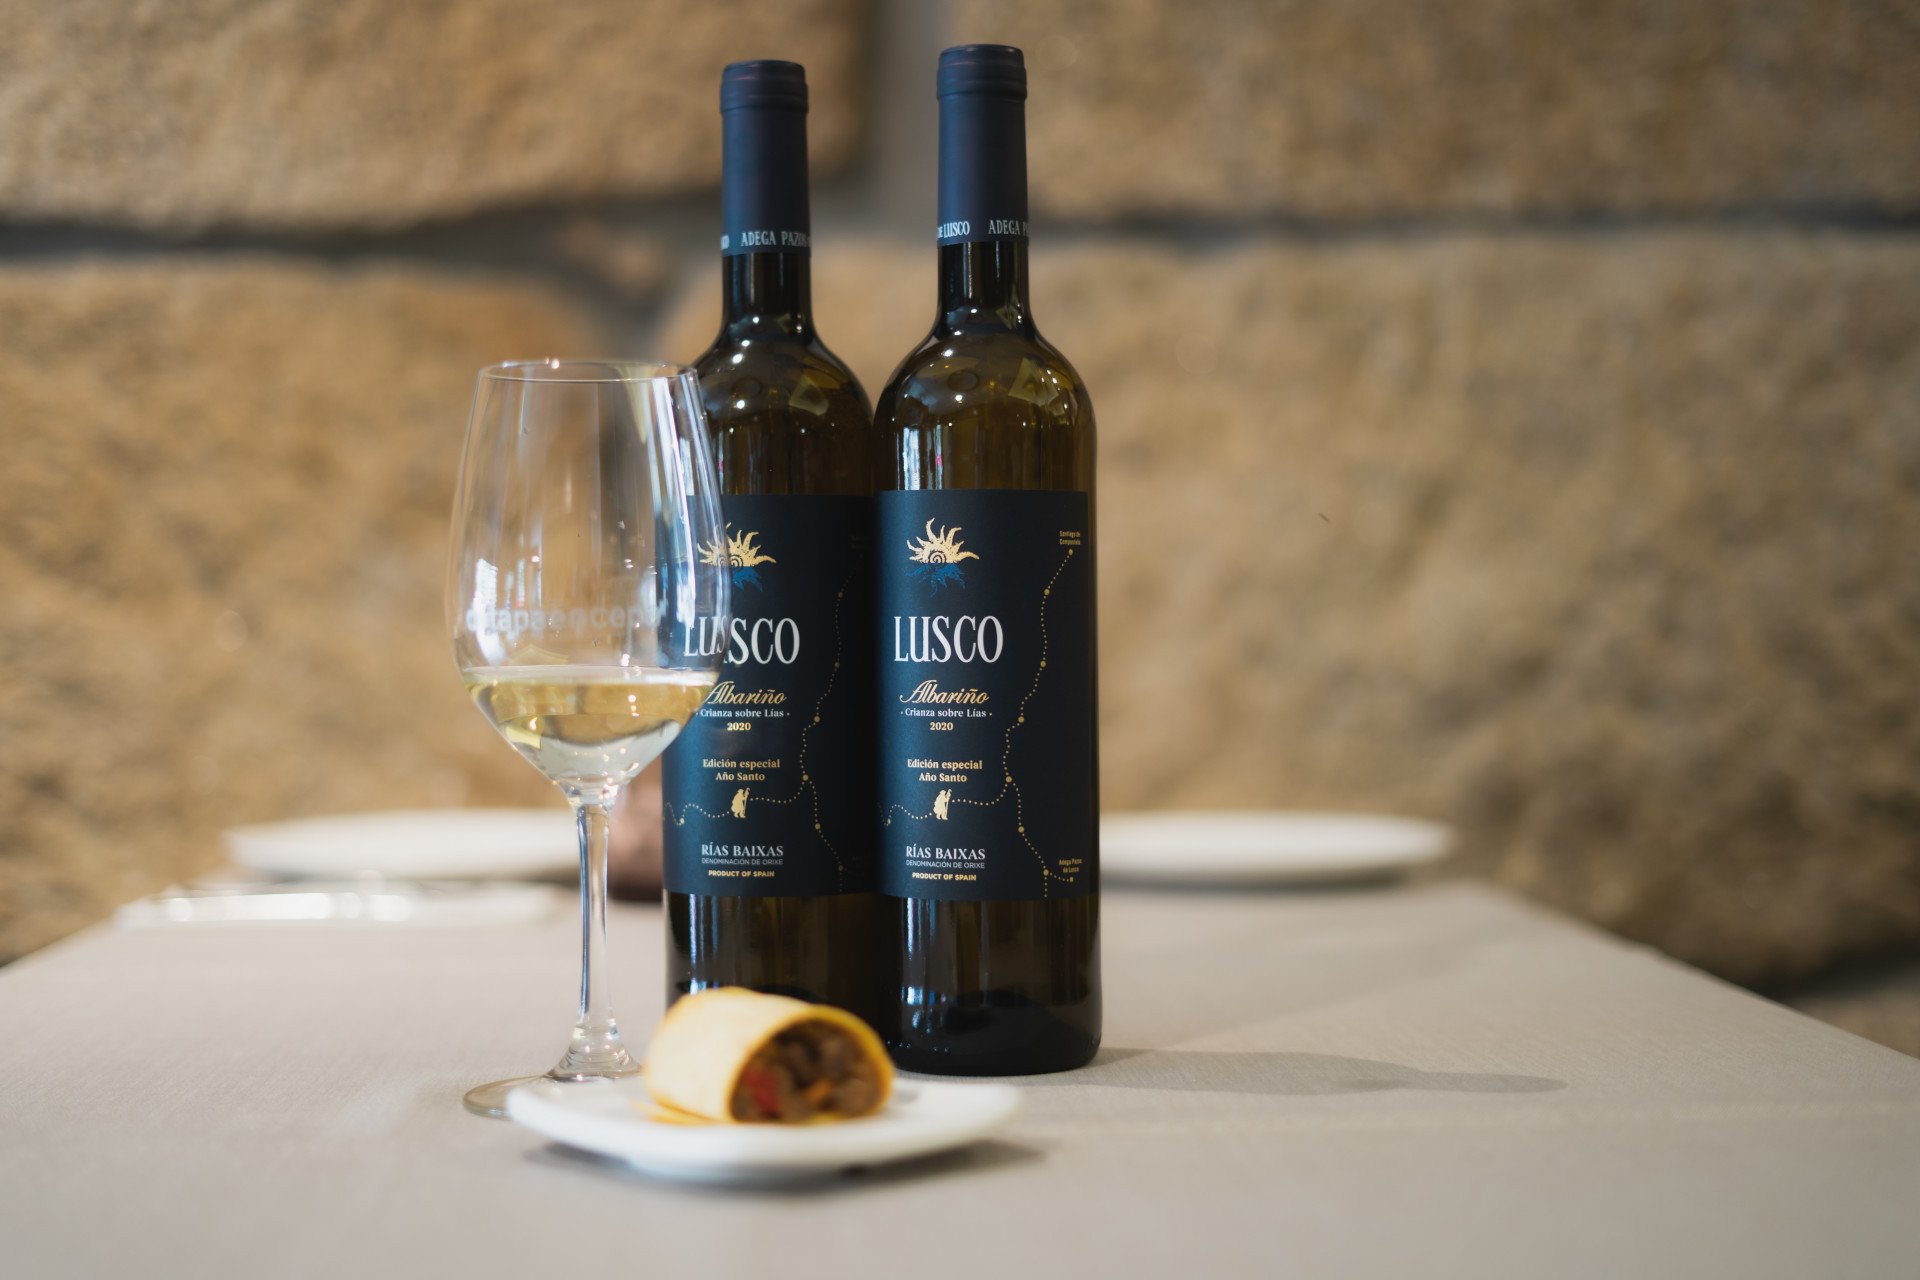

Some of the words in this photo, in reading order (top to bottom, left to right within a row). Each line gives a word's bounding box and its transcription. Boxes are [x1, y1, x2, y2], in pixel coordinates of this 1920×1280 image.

[944, 220, 970, 239] LUSCO
[988, 219, 1021, 236] ADEGA
[741, 231, 777, 247] ADEGA
[894, 615, 1004, 663] LUSCO
[704, 681, 787, 705] Albariño
[899, 679, 990, 704] Albariño
[700, 708, 733, 718] Crianza
[735, 708, 762, 718] sobre
[764, 708, 785, 718] Lías
[905, 707, 935, 717] Crianza
[937, 708, 964, 718] sobre
[966, 708, 987, 718] Lías
[727, 721, 752, 731] 2020
[929, 721, 954, 731] 2020
[702, 758, 737, 769] Edición
[739, 759, 781, 771] especial
[907, 758, 939, 769] Edición
[941, 760, 983, 772] especial
[715, 771, 735, 781] Año
[737, 771, 766, 781] Santo
[918, 772, 937, 782] Año
[939, 773, 967, 783] Santo
[701, 841, 729, 857] RÍAS
[733, 845, 784, 857] BAIXAS
[905, 843, 932, 859] RÍAS
[935, 848, 986, 860] BAIXAS
[701, 857, 750, 866] DENOMINACIÓN
[751, 858, 761, 866] DE
[762, 858, 784, 866] ORIXE
[905, 860, 952, 869] DENOMINACIÓN
[952, 861, 962, 869] DE
[708, 869, 740, 878] PRODUCT
[741, 870, 752, 878] OF
[753, 870, 775, 878] SPAIN
[912, 872, 942, 880] PRODUCT
[943, 873, 954, 881] OF
[954, 873, 977, 881] SPAIN
